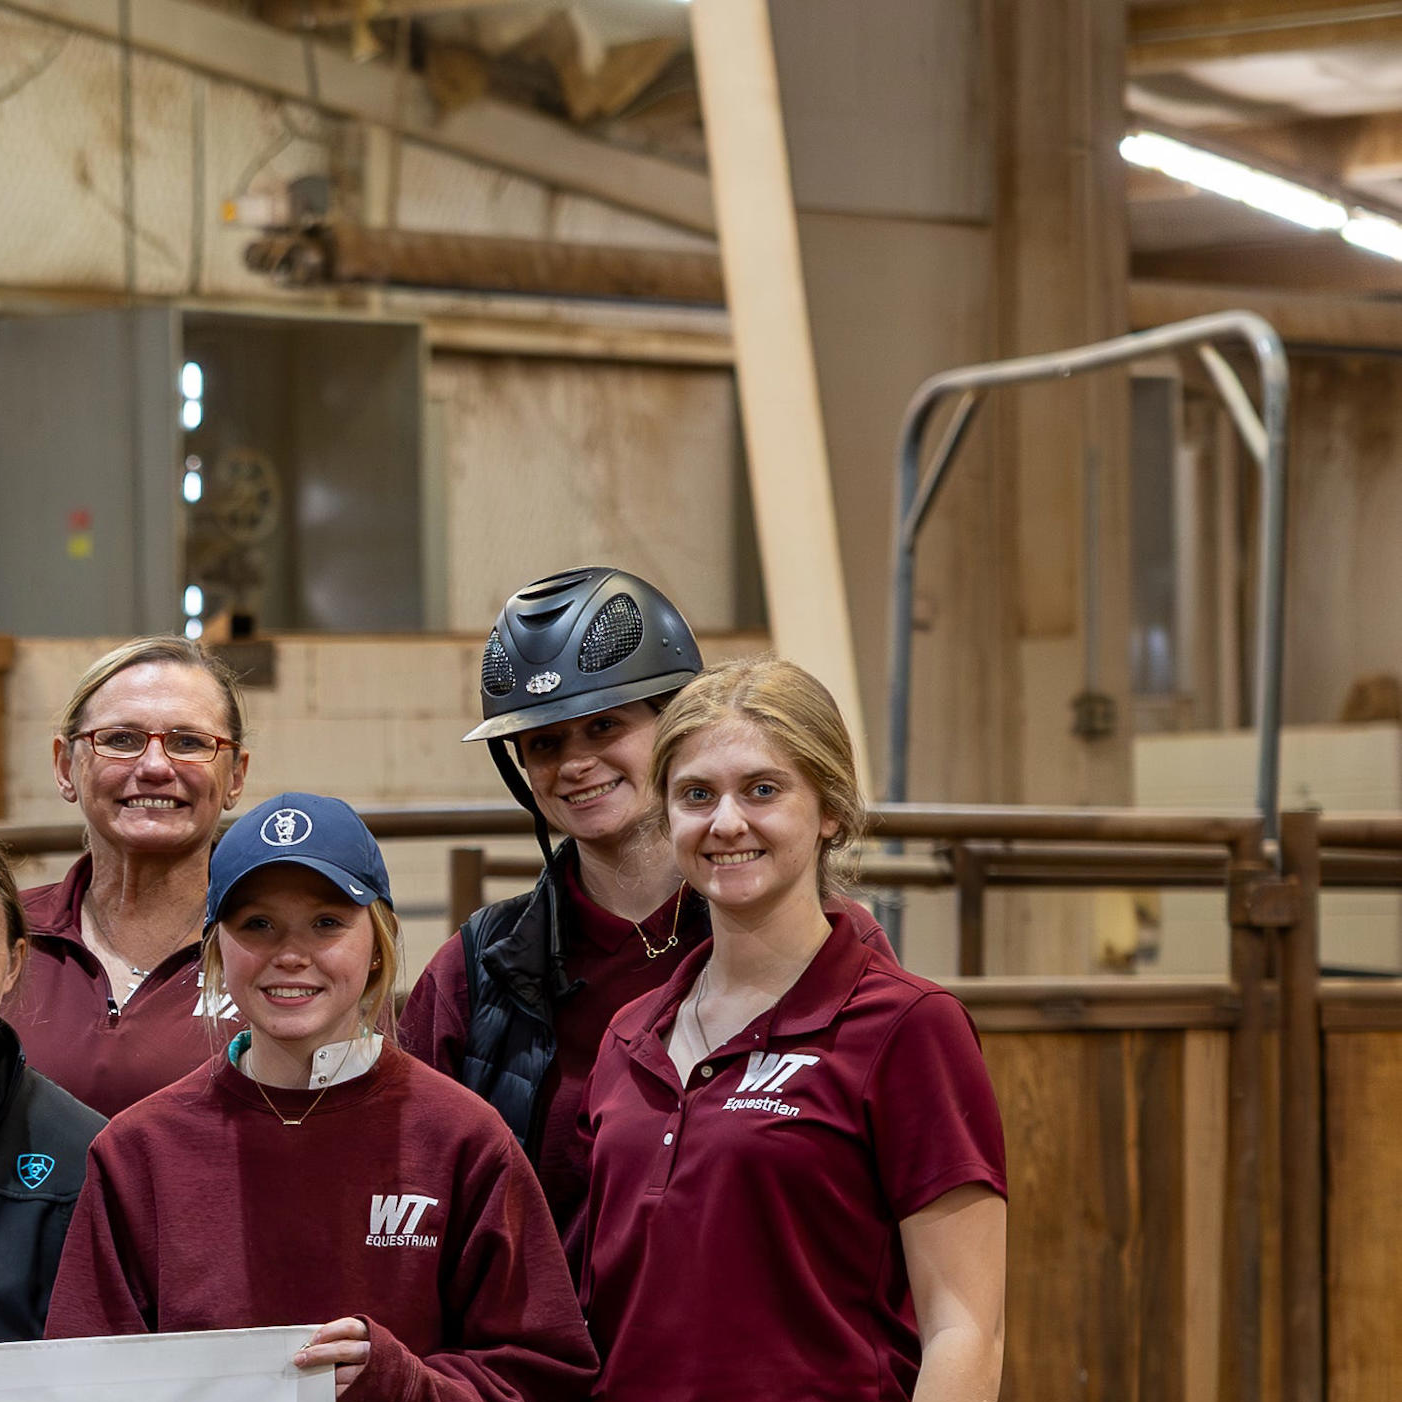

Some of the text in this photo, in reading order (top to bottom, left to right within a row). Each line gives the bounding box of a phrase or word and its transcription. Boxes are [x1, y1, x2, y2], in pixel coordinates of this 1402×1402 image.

[735, 1051, 821, 1093] WT
[722, 1096, 800, 1117] Equestrian
[370, 1194, 439, 1235] WT
[365, 1234, 438, 1248] EQUESTRIAN
